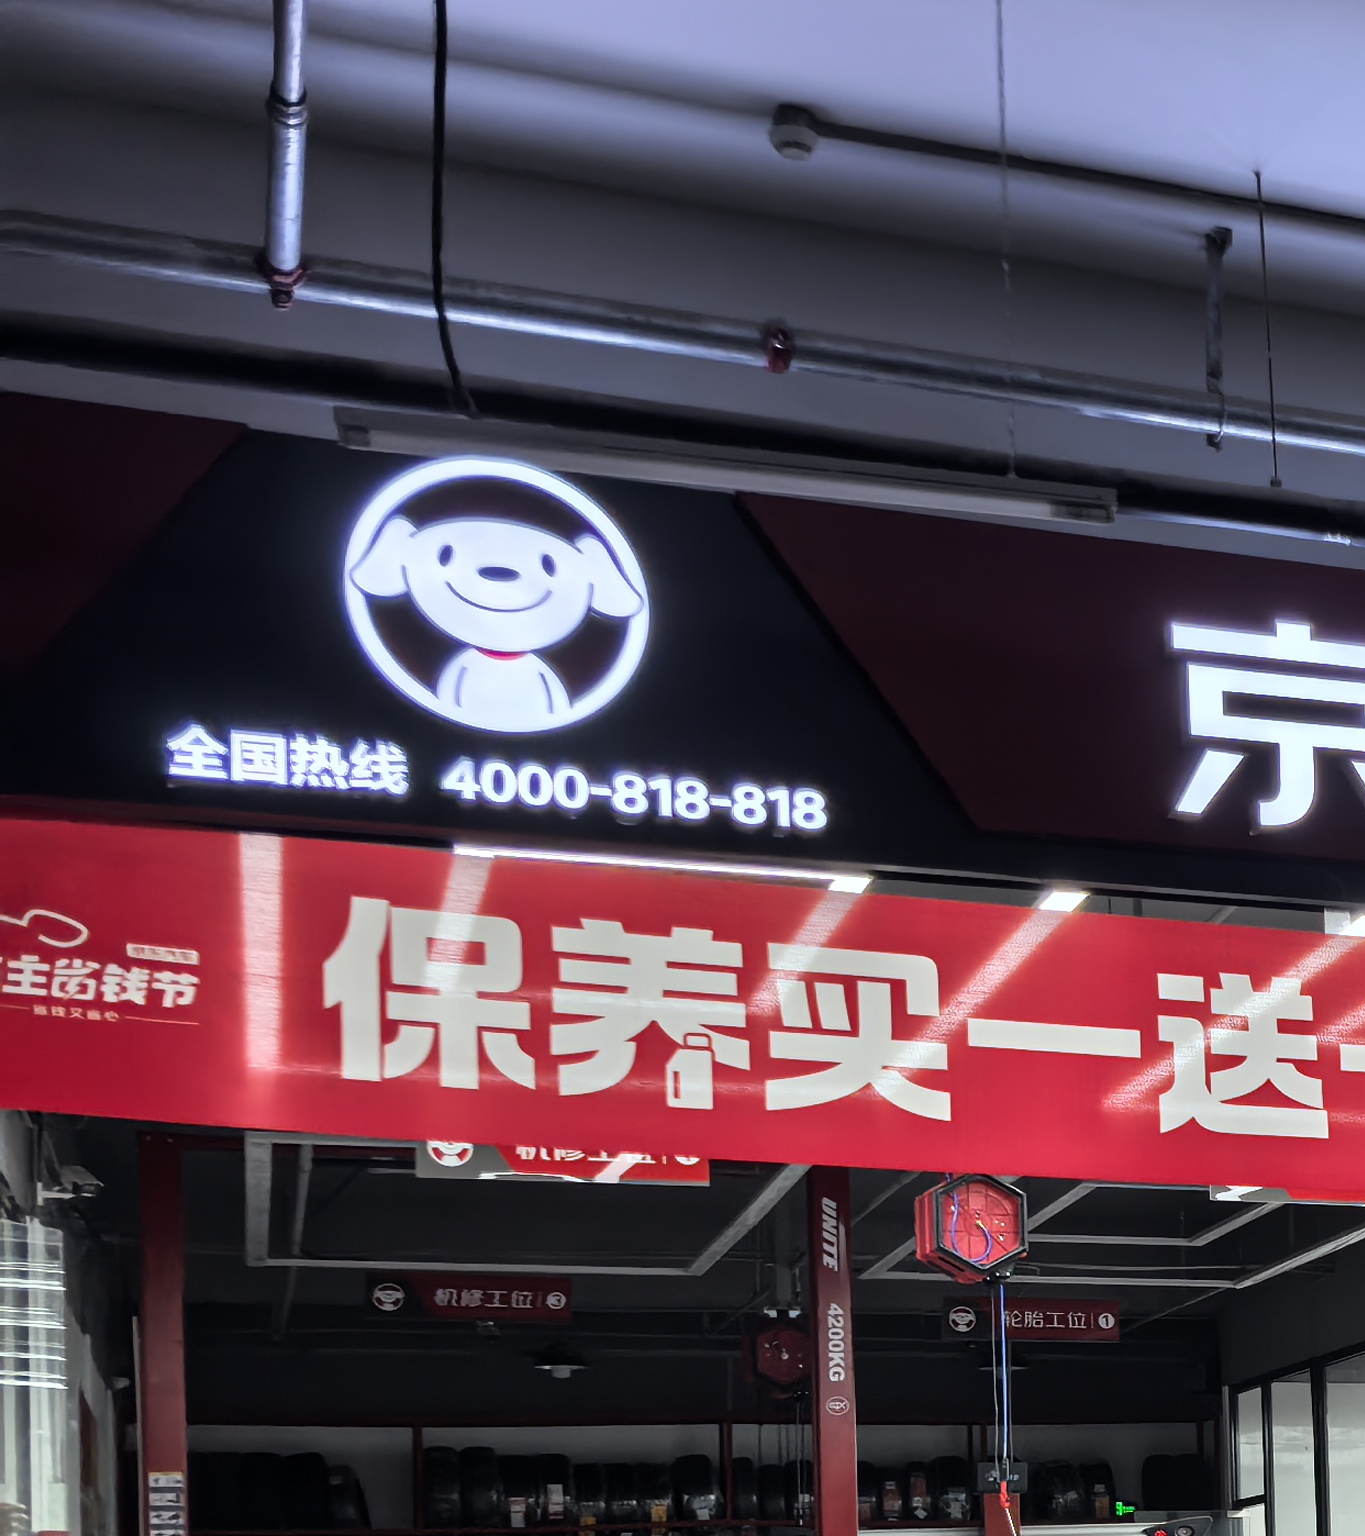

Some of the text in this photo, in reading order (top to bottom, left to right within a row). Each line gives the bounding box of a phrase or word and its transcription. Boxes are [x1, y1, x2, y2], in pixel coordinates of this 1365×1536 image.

[165, 723, 828, 830] 全国热线 4000-818-818
[0, 954, 200, 1009] 主省钱节
[822, 1196, 838, 1272] UNITE
[828, 1302, 845, 1382] 4200KG
